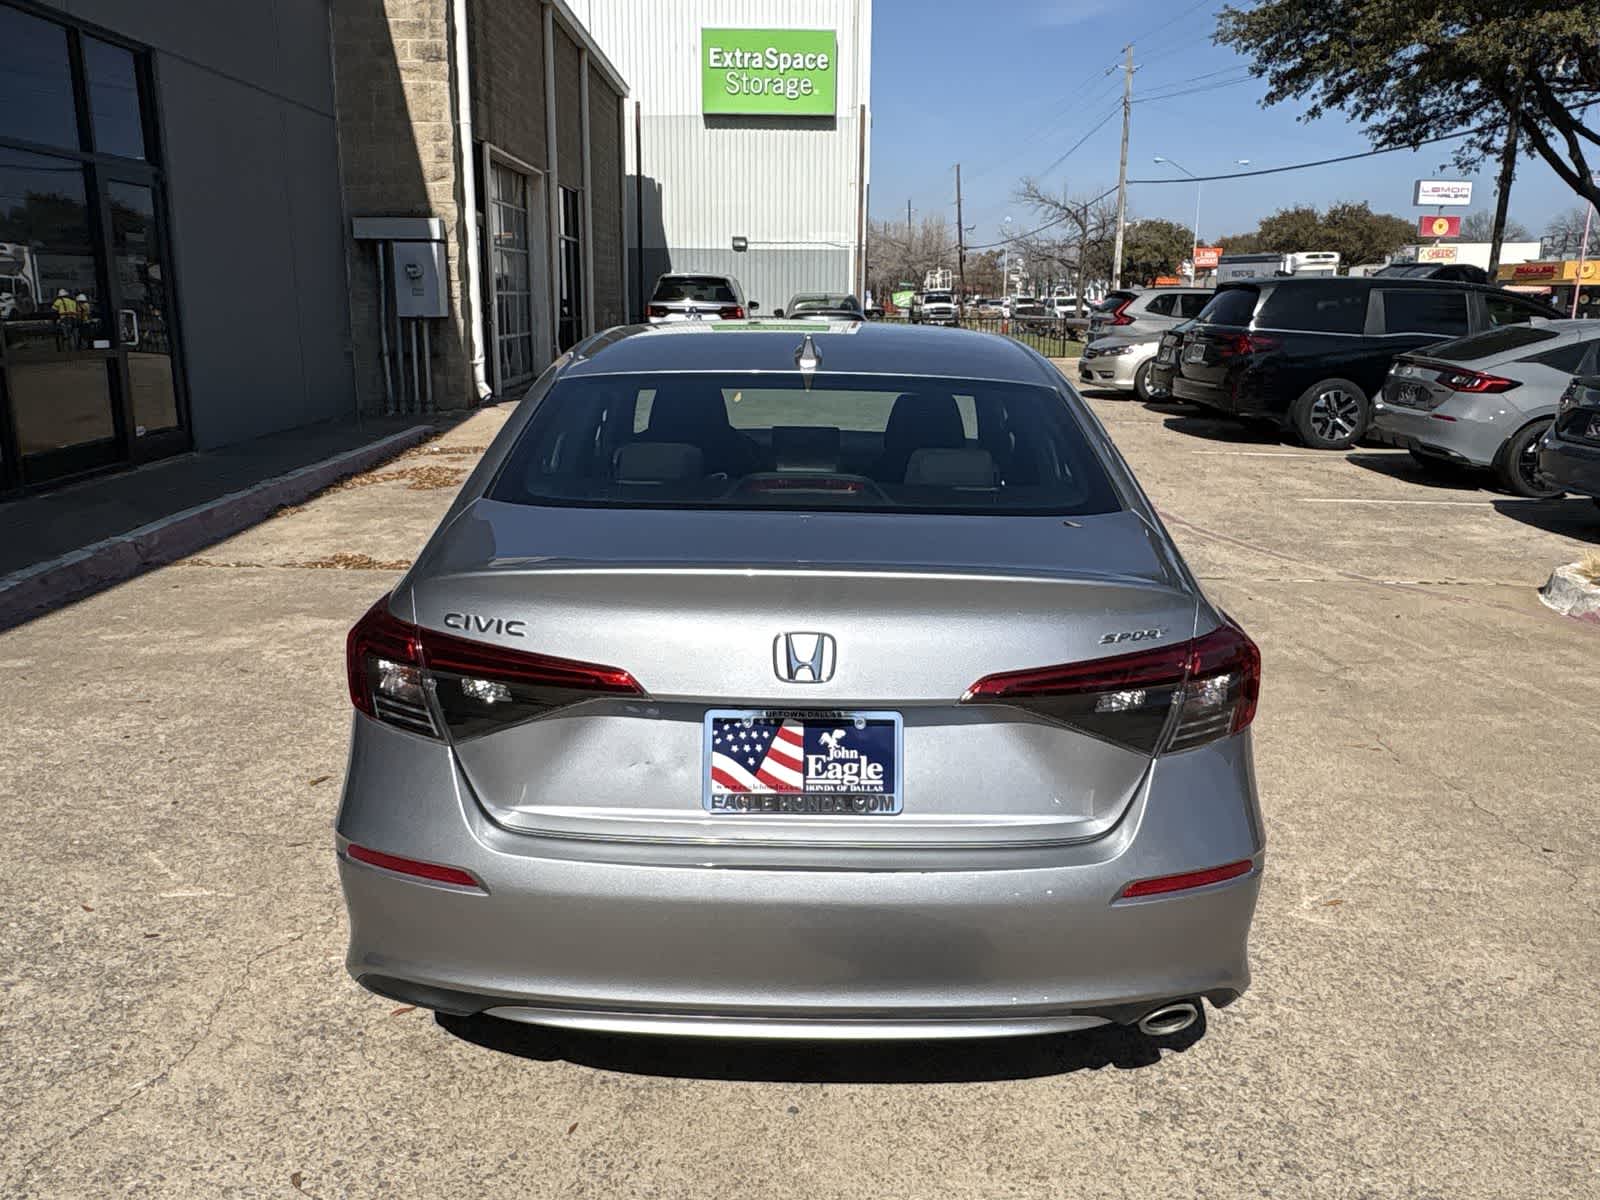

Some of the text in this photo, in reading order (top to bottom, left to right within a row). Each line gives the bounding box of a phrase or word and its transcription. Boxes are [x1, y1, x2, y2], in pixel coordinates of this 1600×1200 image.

[708, 47, 830, 75] ExtraSpace
[725, 71, 813, 100] Storage
[443, 613, 526, 637] CIVIC
[765, 710, 843, 719] UPTOWN DALLAS
[827, 743, 858, 760] John
[806, 755, 883, 785] Eagle
[806, 784, 884, 792] HONDA OF DALLAS
